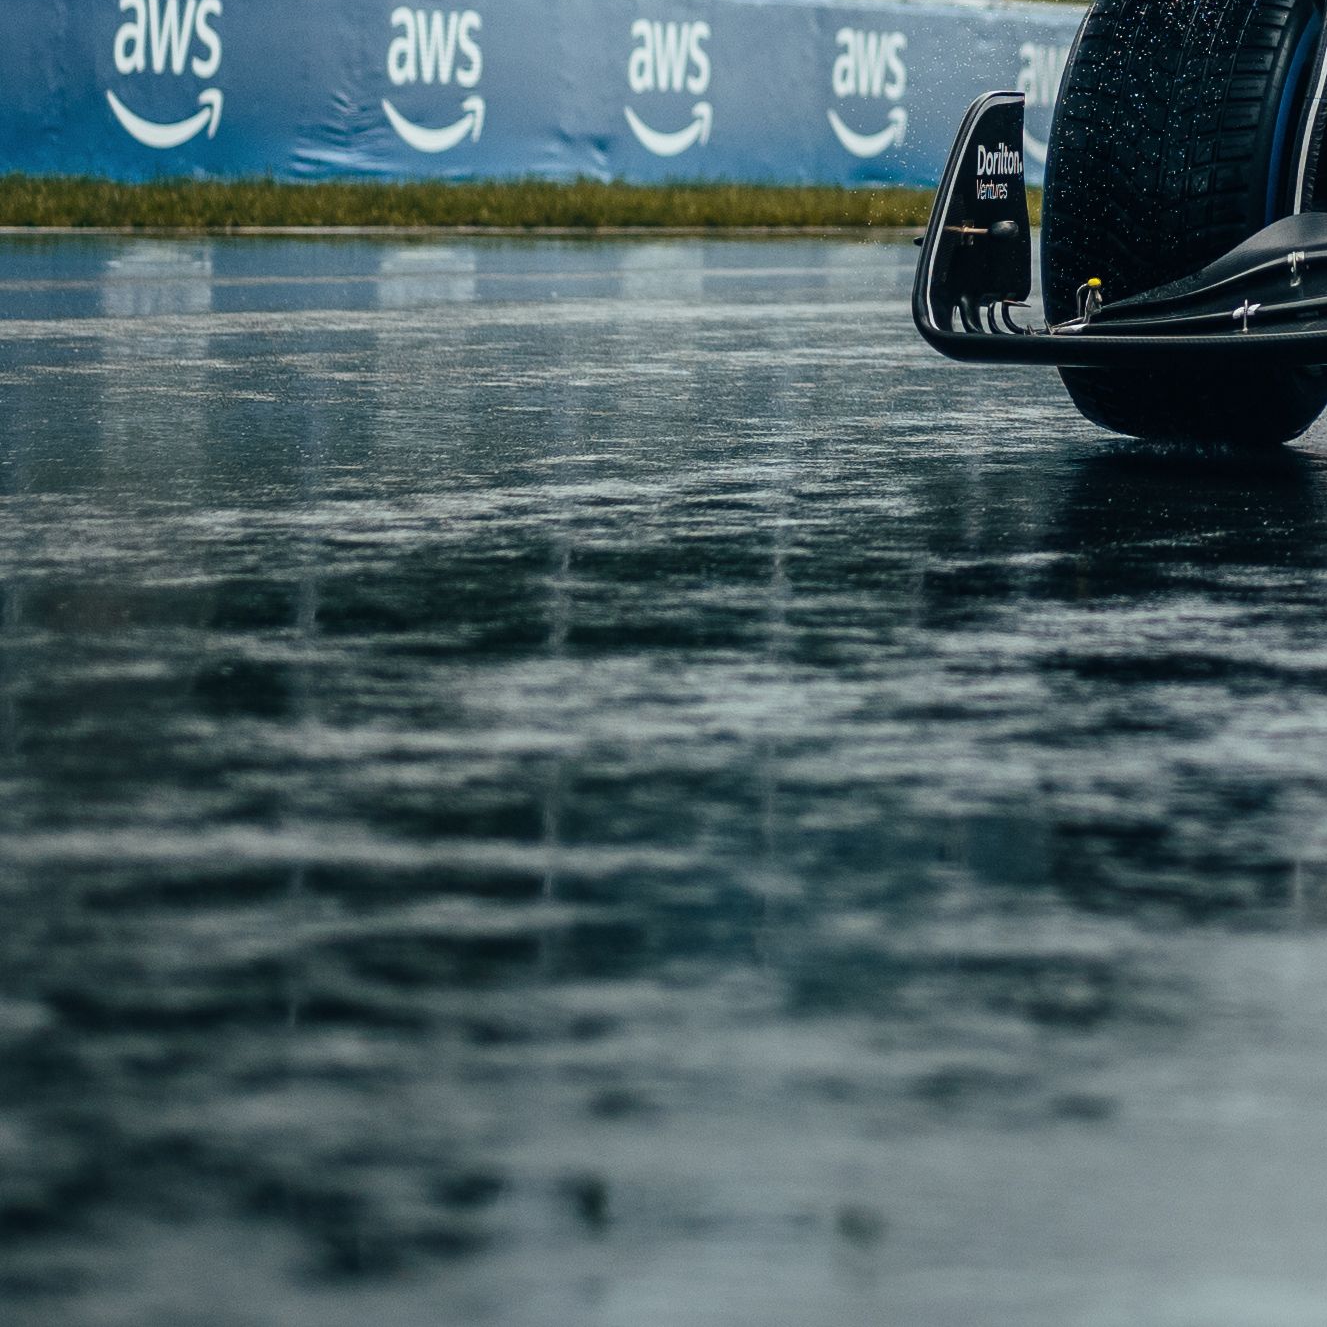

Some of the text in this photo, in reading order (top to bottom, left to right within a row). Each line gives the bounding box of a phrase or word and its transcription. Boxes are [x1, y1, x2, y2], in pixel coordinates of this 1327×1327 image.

[387, 6, 484, 88] aws
[628, 18, 712, 95] aws
[832, 27, 908, 102] aws
[1017, 42, 1070, 108] aw
[976, 179, 1008, 200] Ventures
